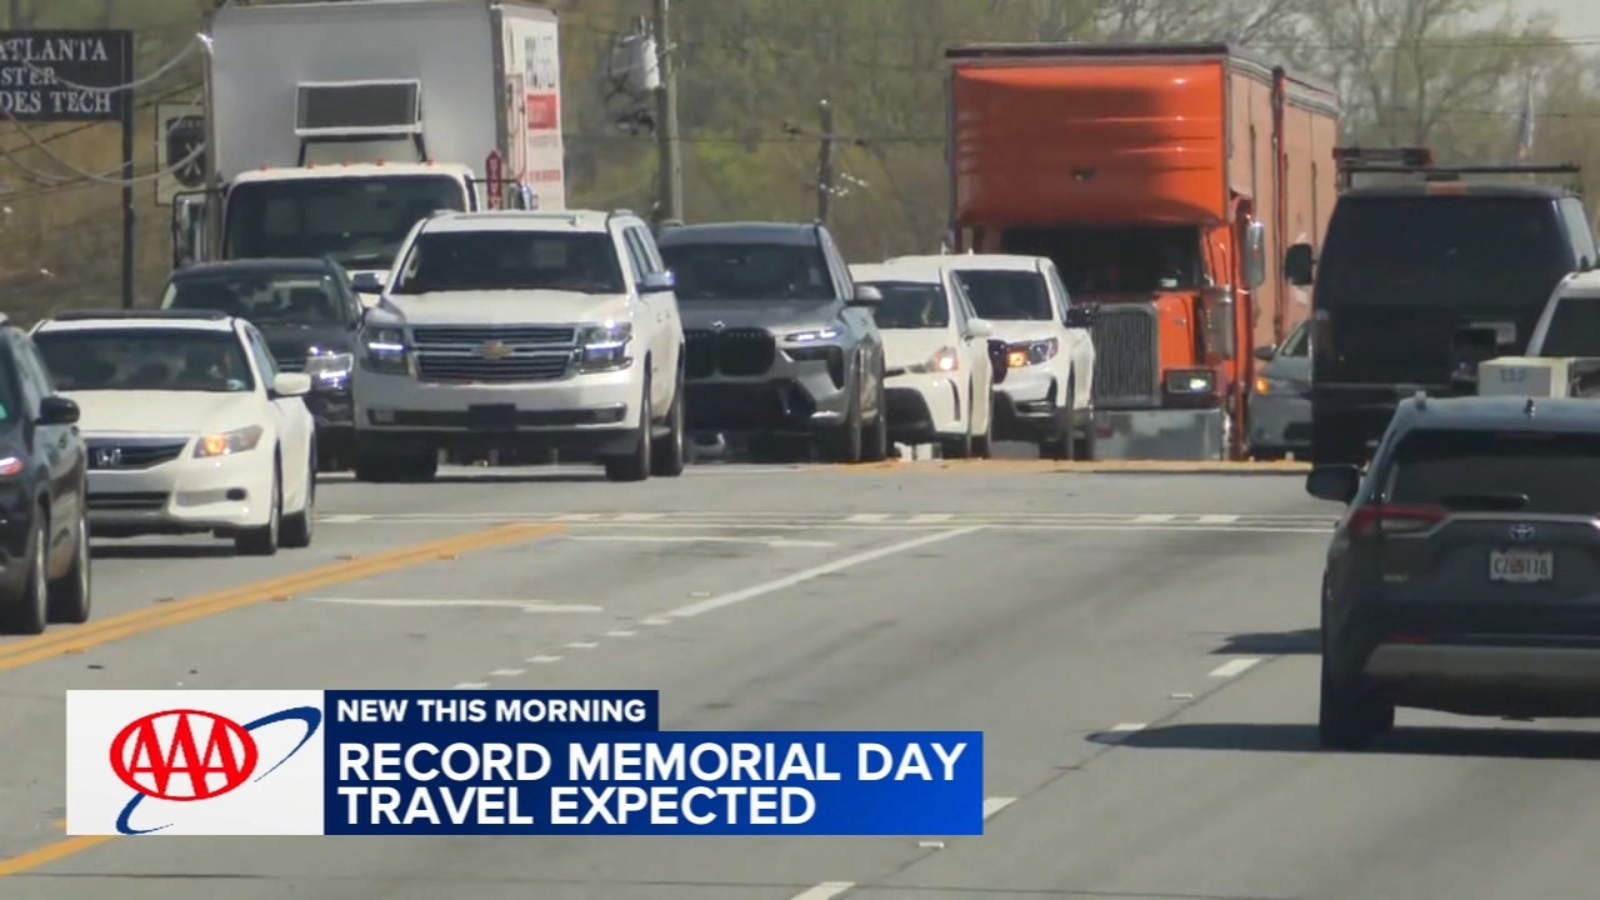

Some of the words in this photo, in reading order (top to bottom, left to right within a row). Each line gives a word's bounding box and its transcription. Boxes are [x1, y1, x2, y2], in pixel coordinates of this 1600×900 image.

[0, 37, 108, 61] ATLANTA
[0, 90, 41, 113] DES
[50, 90, 112, 113] TECH
